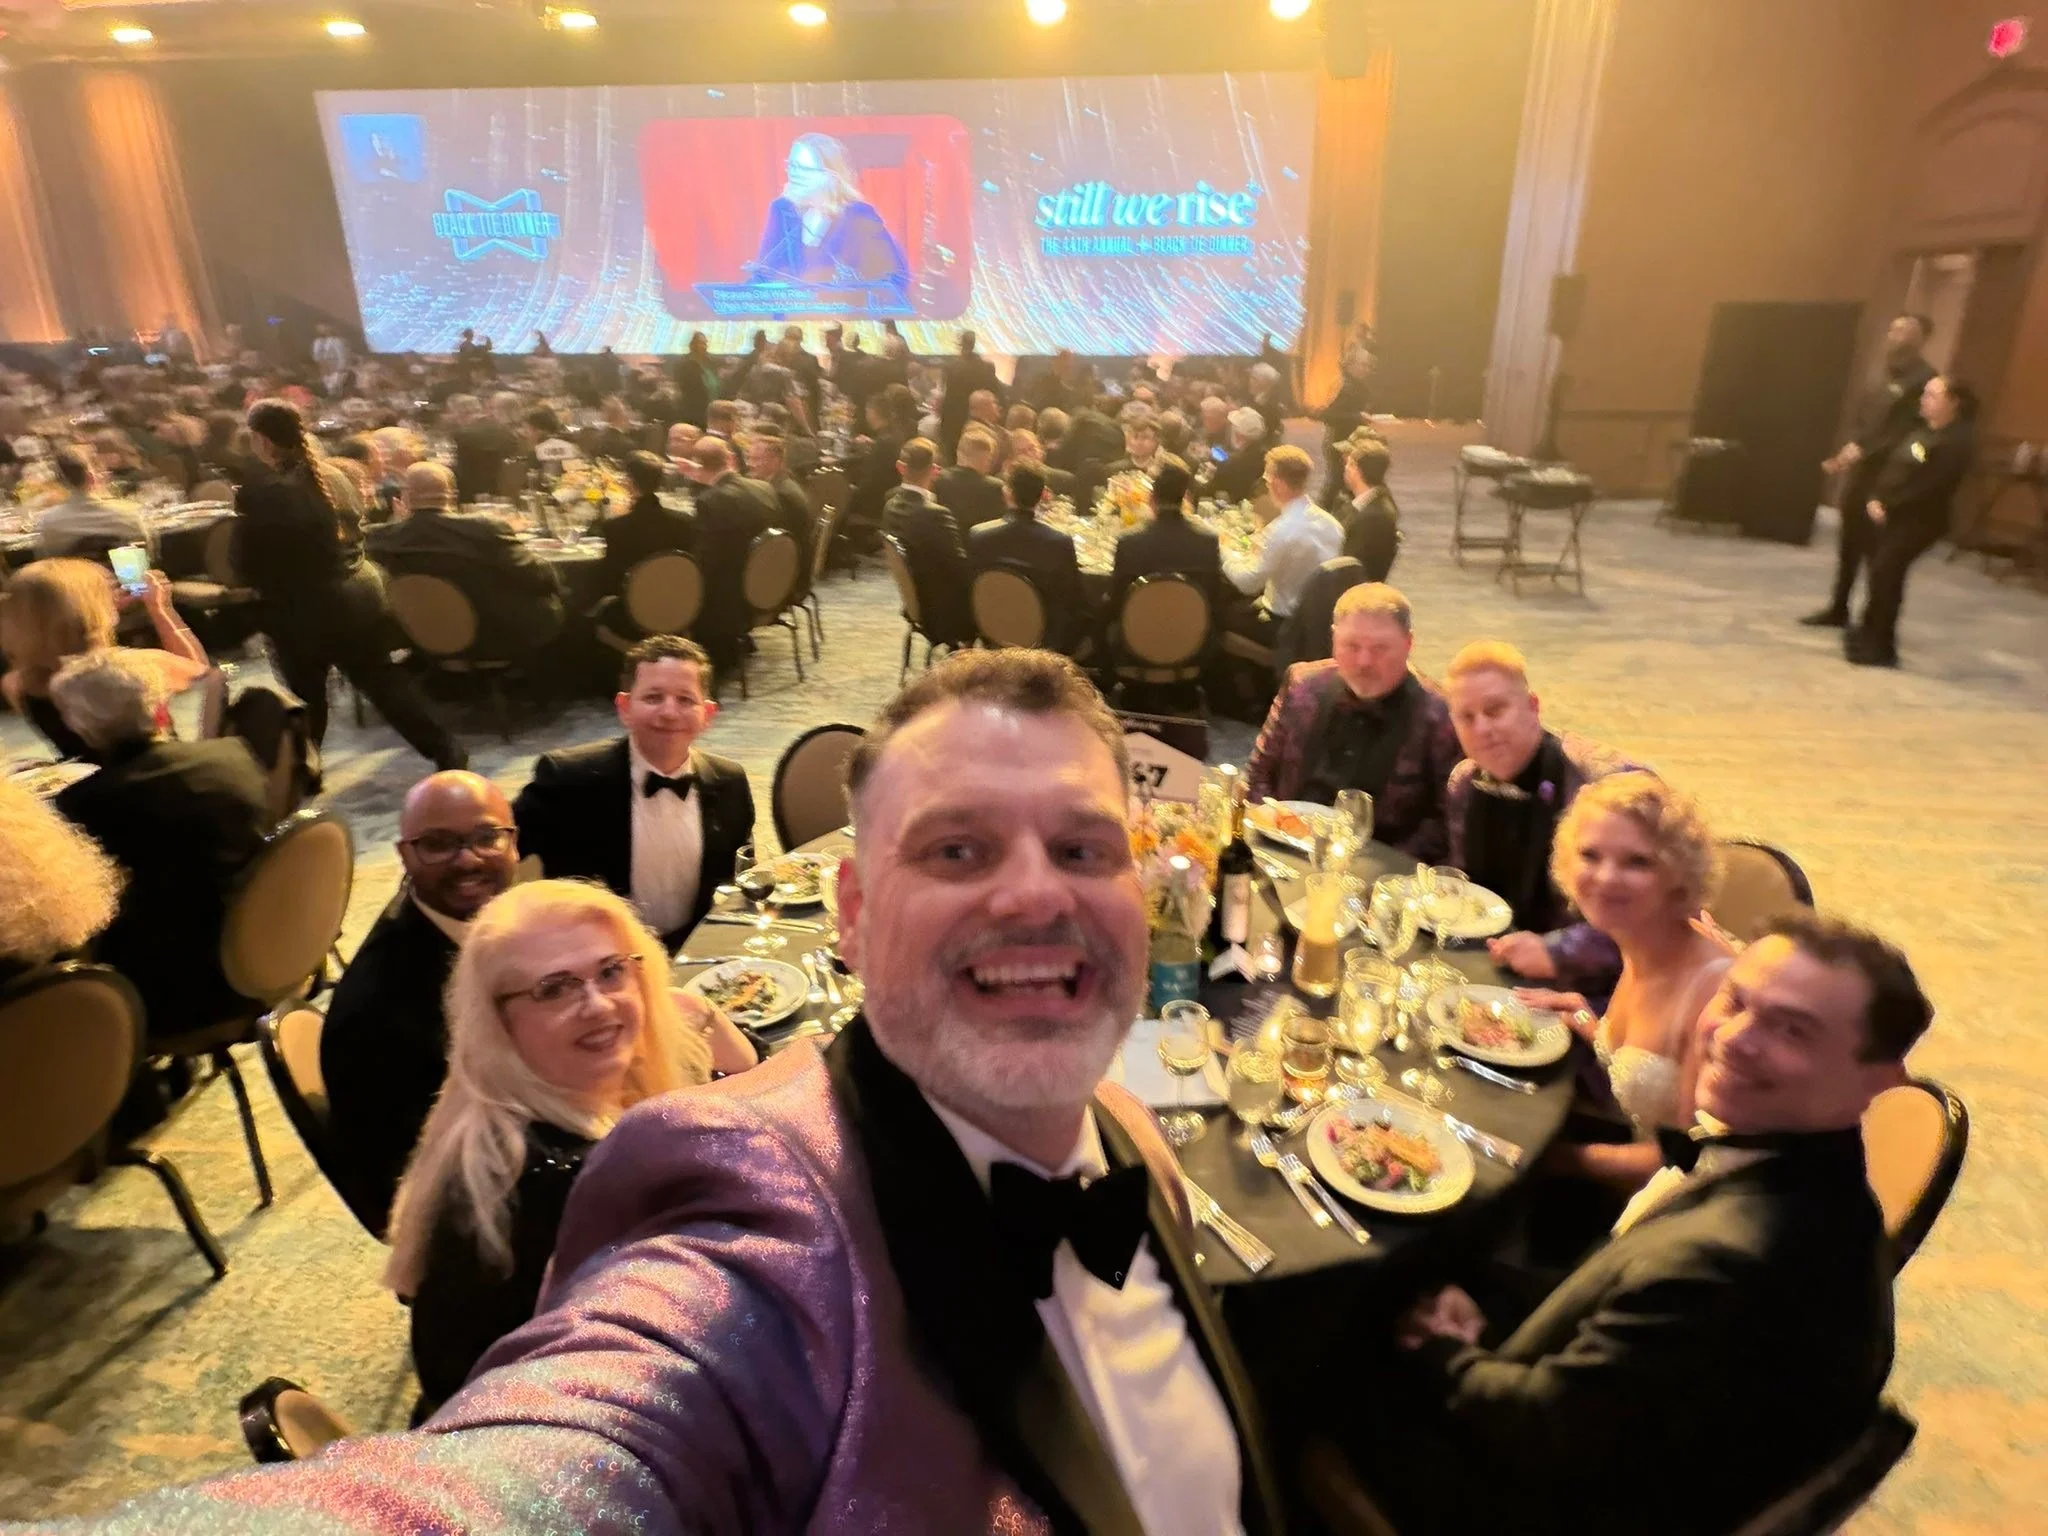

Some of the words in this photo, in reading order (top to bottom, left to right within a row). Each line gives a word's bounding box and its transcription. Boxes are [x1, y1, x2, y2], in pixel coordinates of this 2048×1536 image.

[1035, 180, 1108, 229] still
[1111, 192, 1172, 228] we
[1174, 179, 1257, 228] rise
[432, 212, 476, 238] BLACK
[480, 212, 504, 238] TIE
[503, 212, 554, 238] DINNER
[1040, 236, 1058, 256] THE
[1091, 235, 1134, 256] ANNUAL
[1152, 235, 1186, 256] BLACK
[1208, 235, 1250, 256] DINNER
